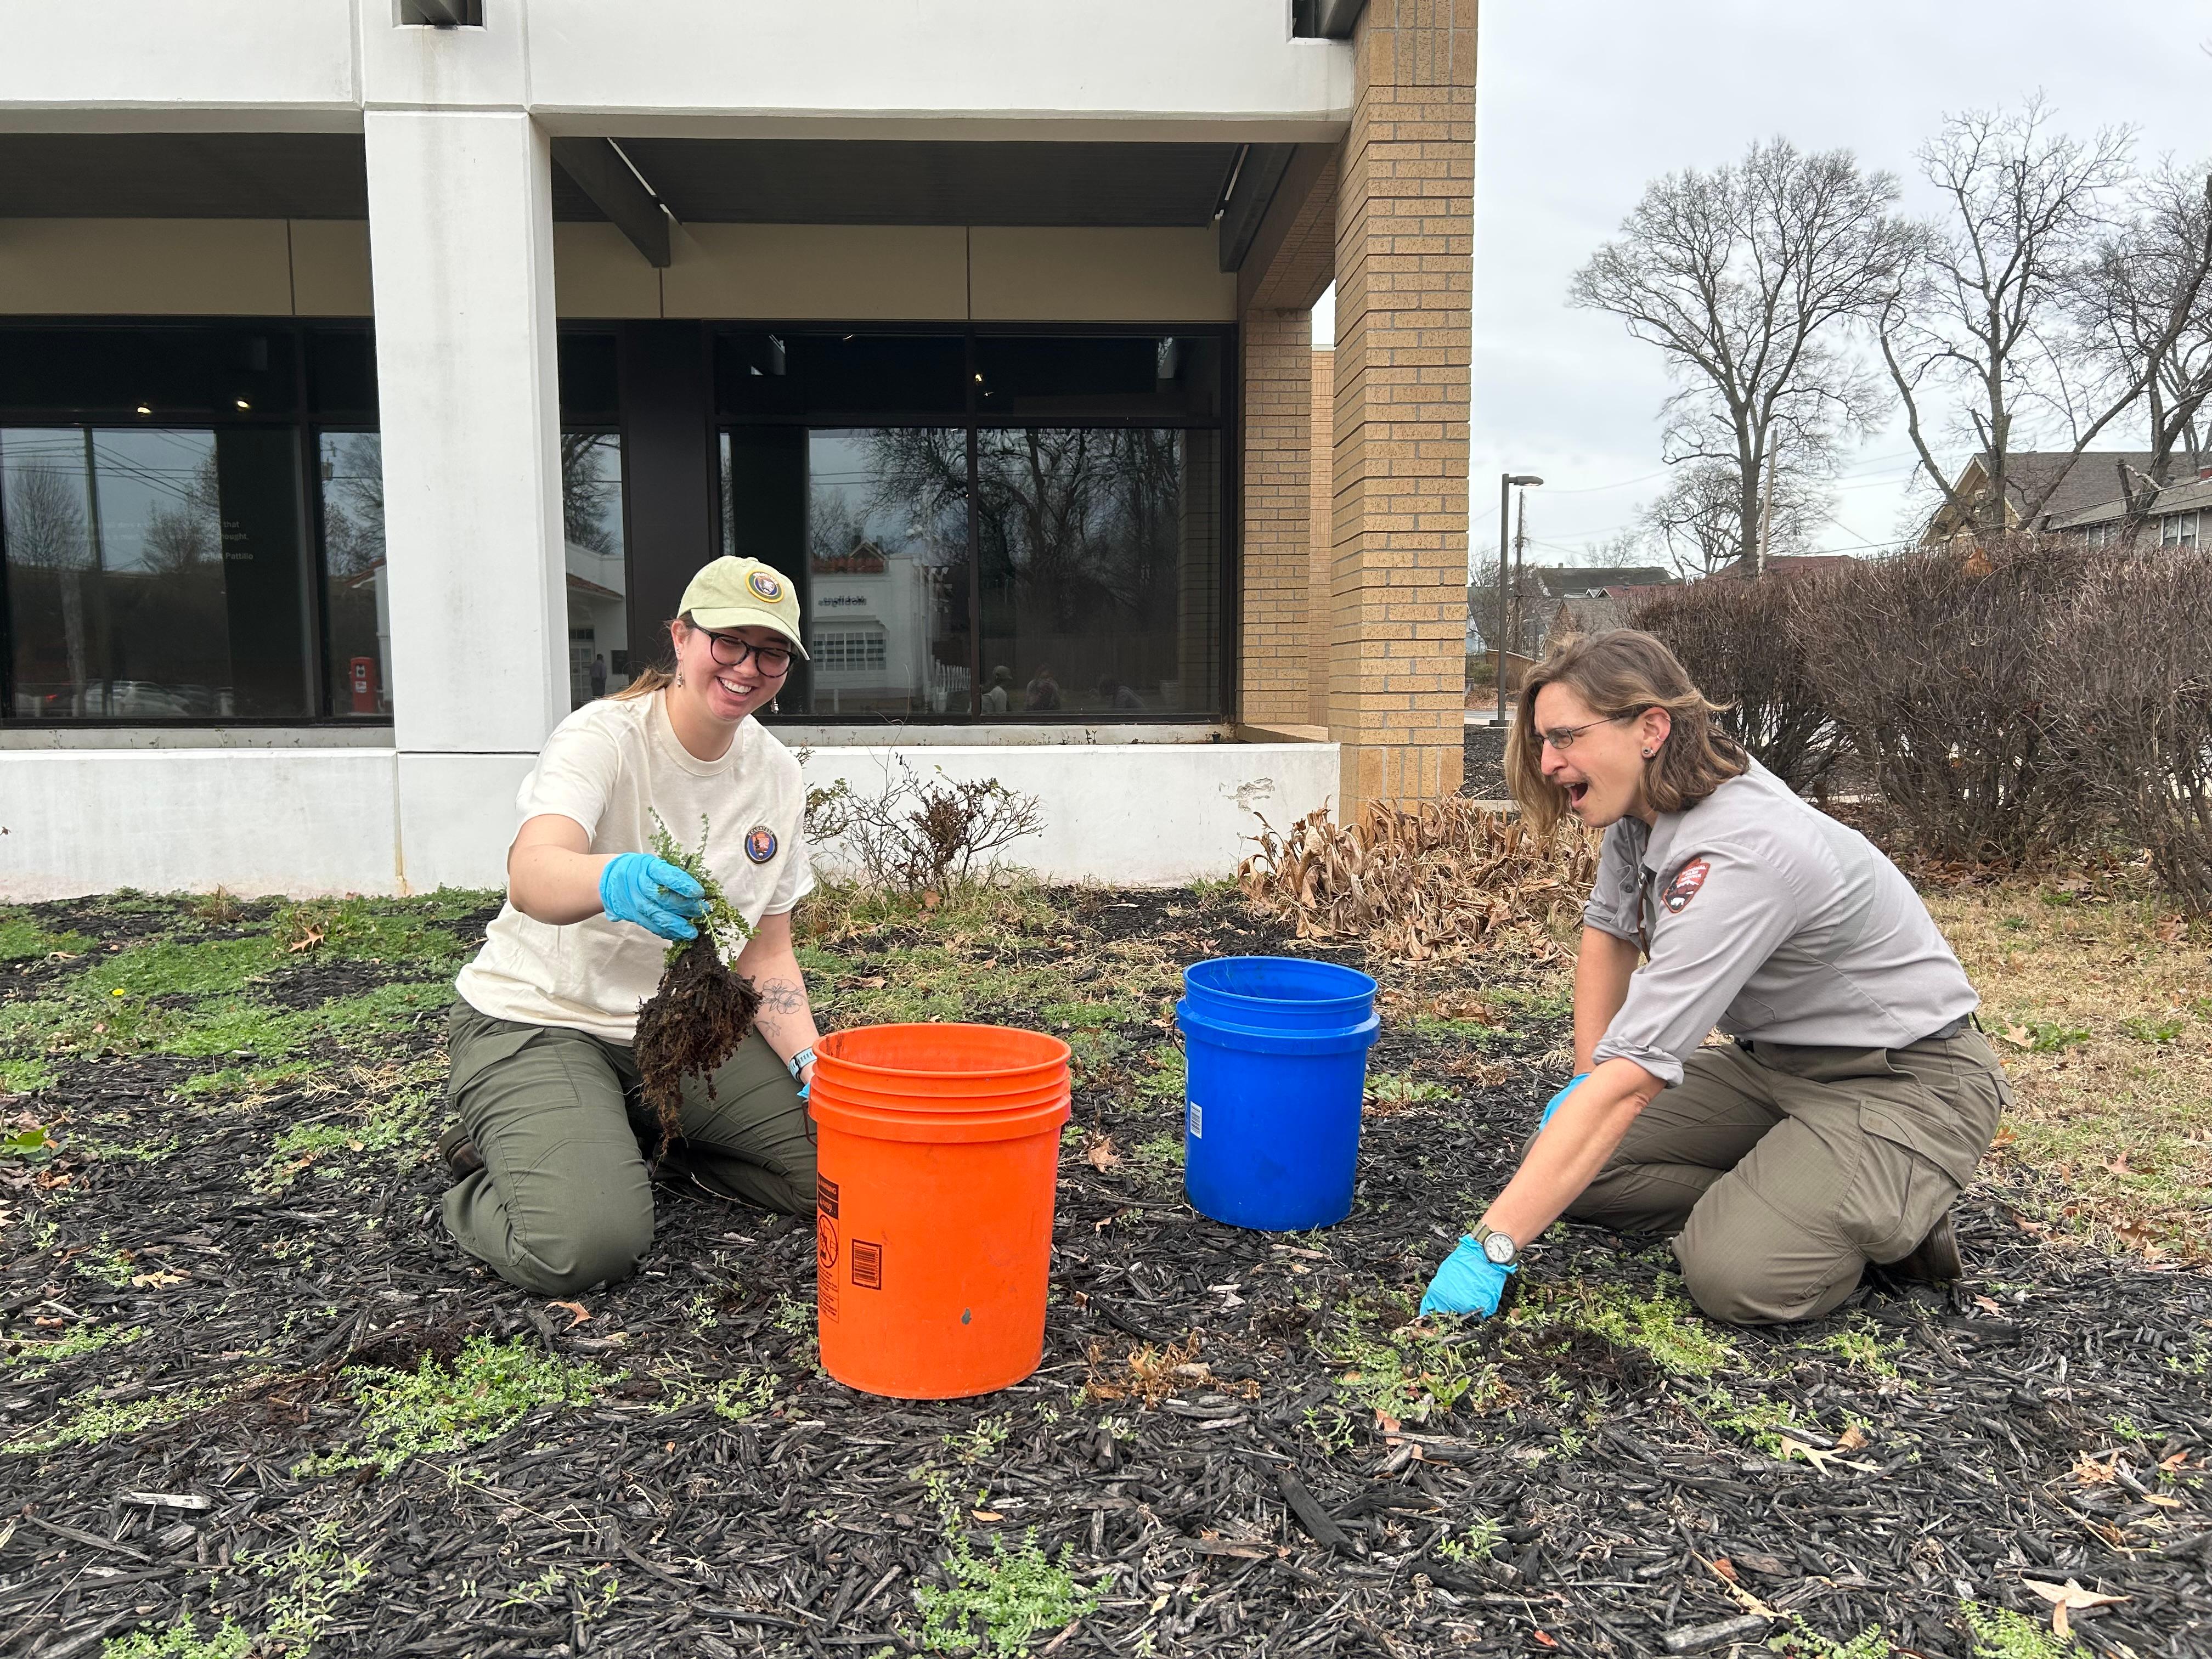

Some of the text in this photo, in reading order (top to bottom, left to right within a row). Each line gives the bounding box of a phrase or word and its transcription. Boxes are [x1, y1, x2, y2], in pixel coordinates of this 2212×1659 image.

[219, 533, 250, 541] hought.
[225, 552, 254, 560] Pattillo
[1681, 866, 1706, 875] NATIONAL
